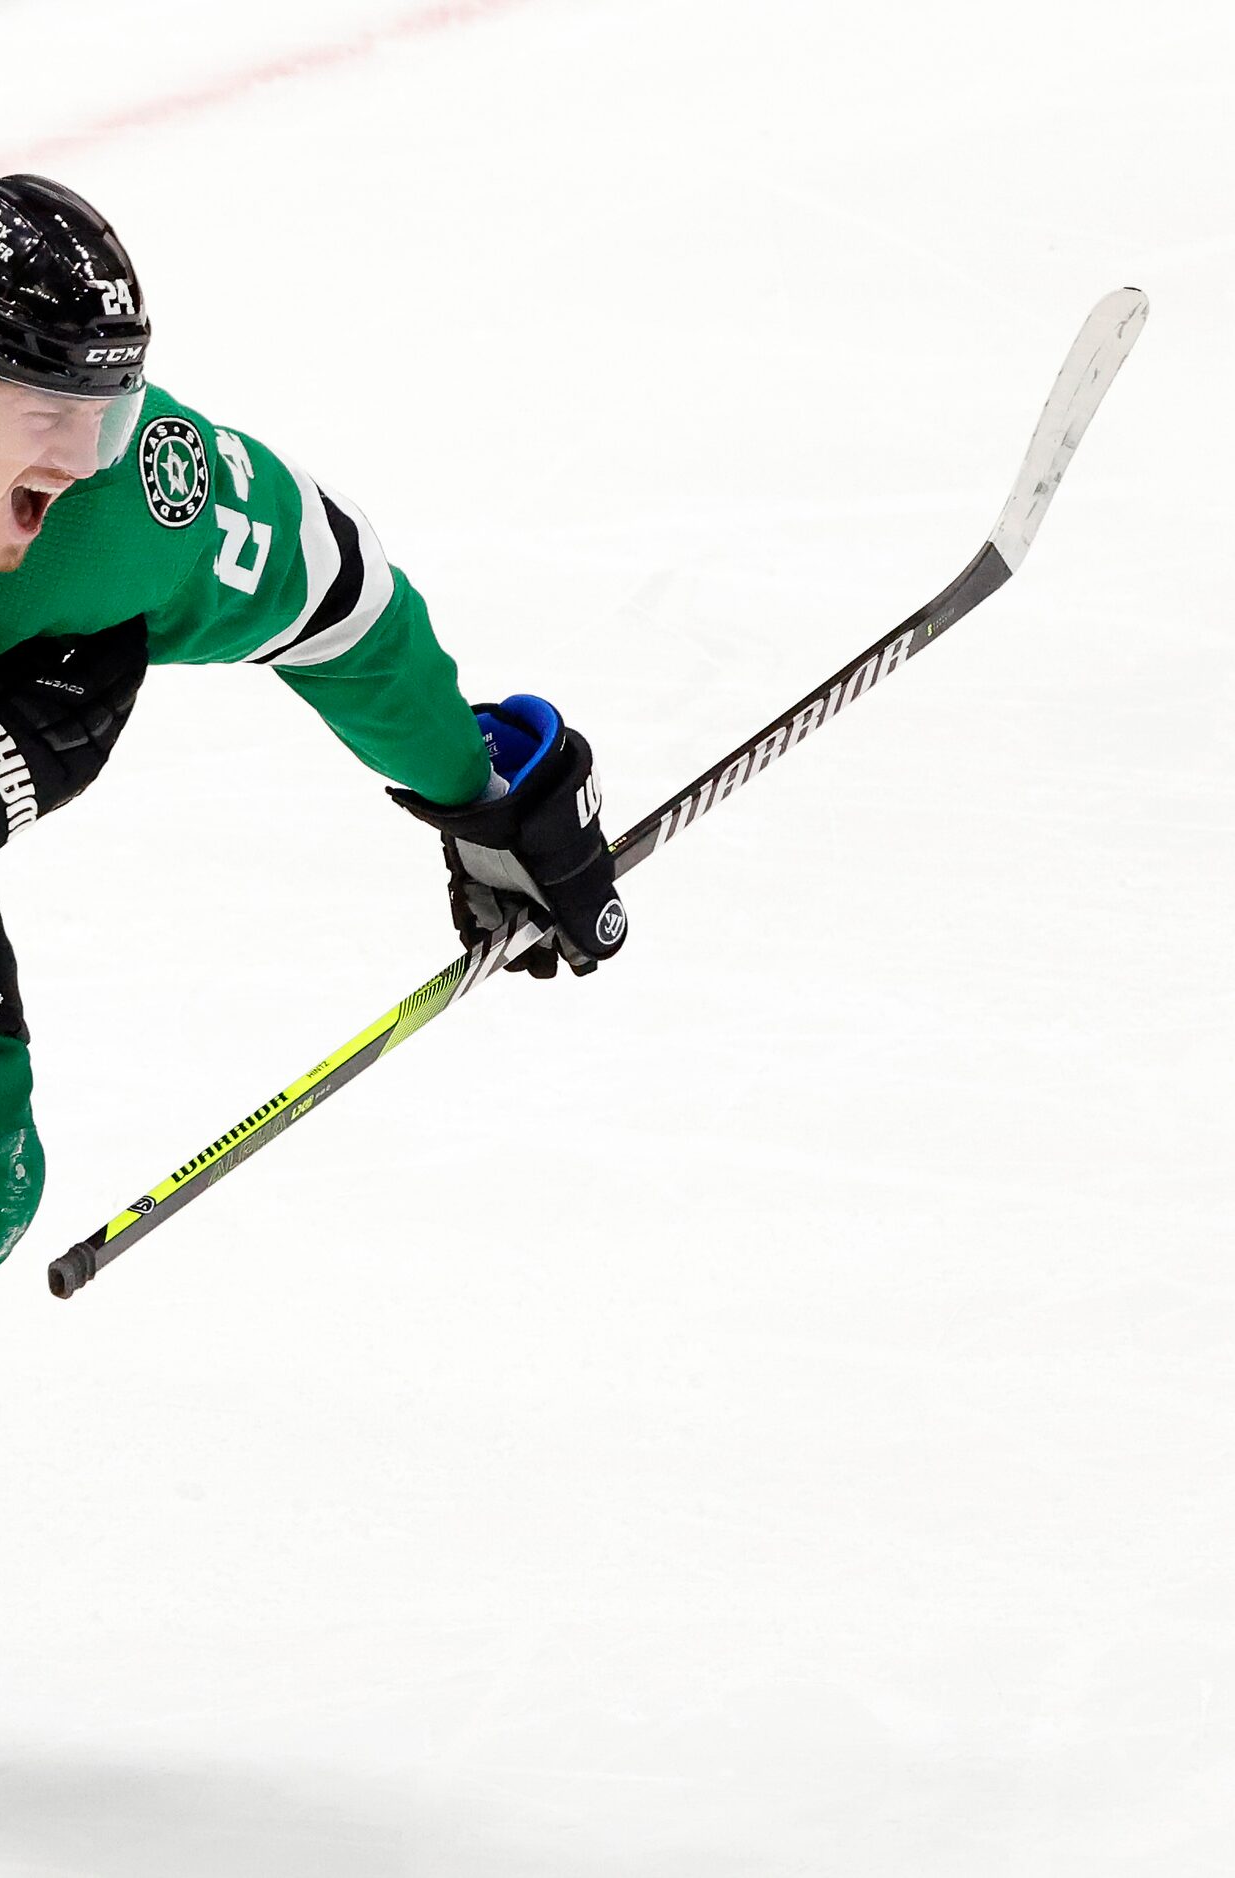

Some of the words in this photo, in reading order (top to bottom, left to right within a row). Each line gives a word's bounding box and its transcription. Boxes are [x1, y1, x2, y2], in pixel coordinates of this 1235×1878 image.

[99, 279, 135, 315] 24
[86, 346, 143, 362] CCM
[213, 428, 272, 595] 24
[36, 677, 84, 694] COVERT
[653, 628, 915, 852] WARRIOR
[306, 1060, 329, 1078] HINTZ
[171, 1092, 288, 1183] WARRIOR
